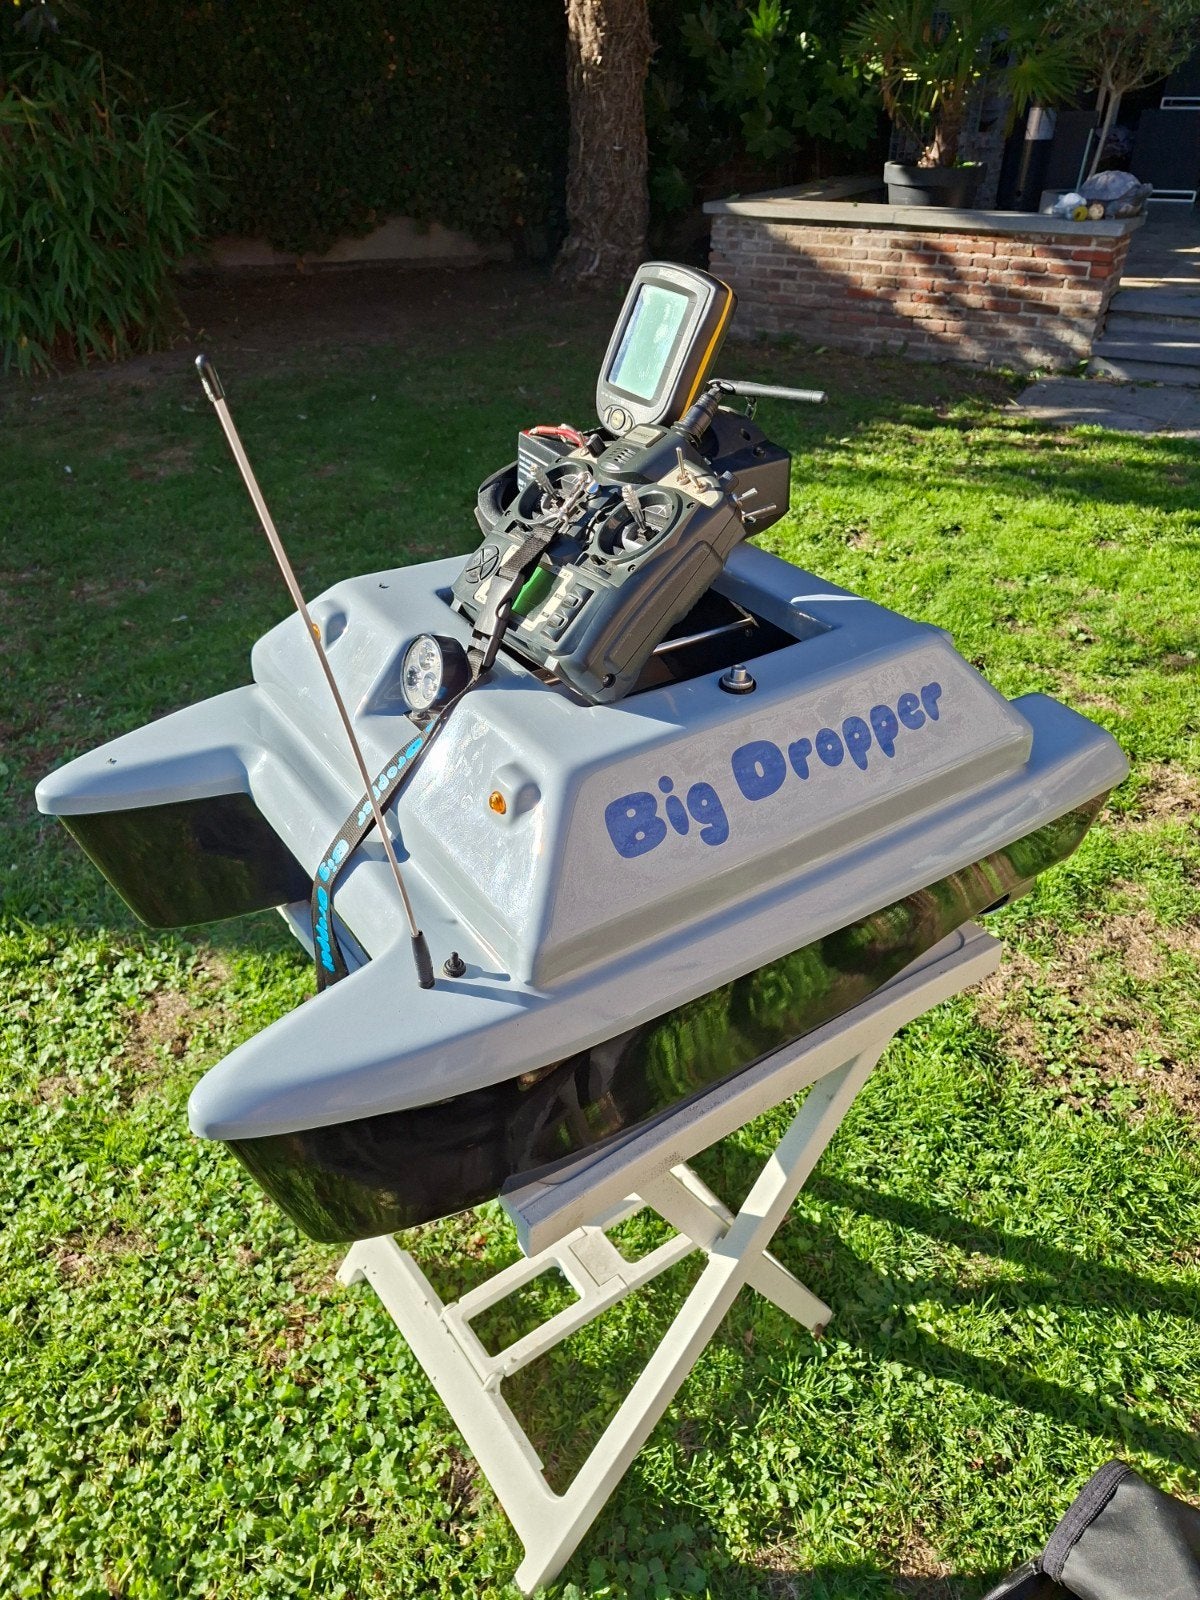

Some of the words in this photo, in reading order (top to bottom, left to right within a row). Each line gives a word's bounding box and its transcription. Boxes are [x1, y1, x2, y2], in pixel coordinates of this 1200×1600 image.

[605, 776, 729, 859] Big
[731, 682, 942, 801] Dropper
[317, 838, 350, 883] Big
